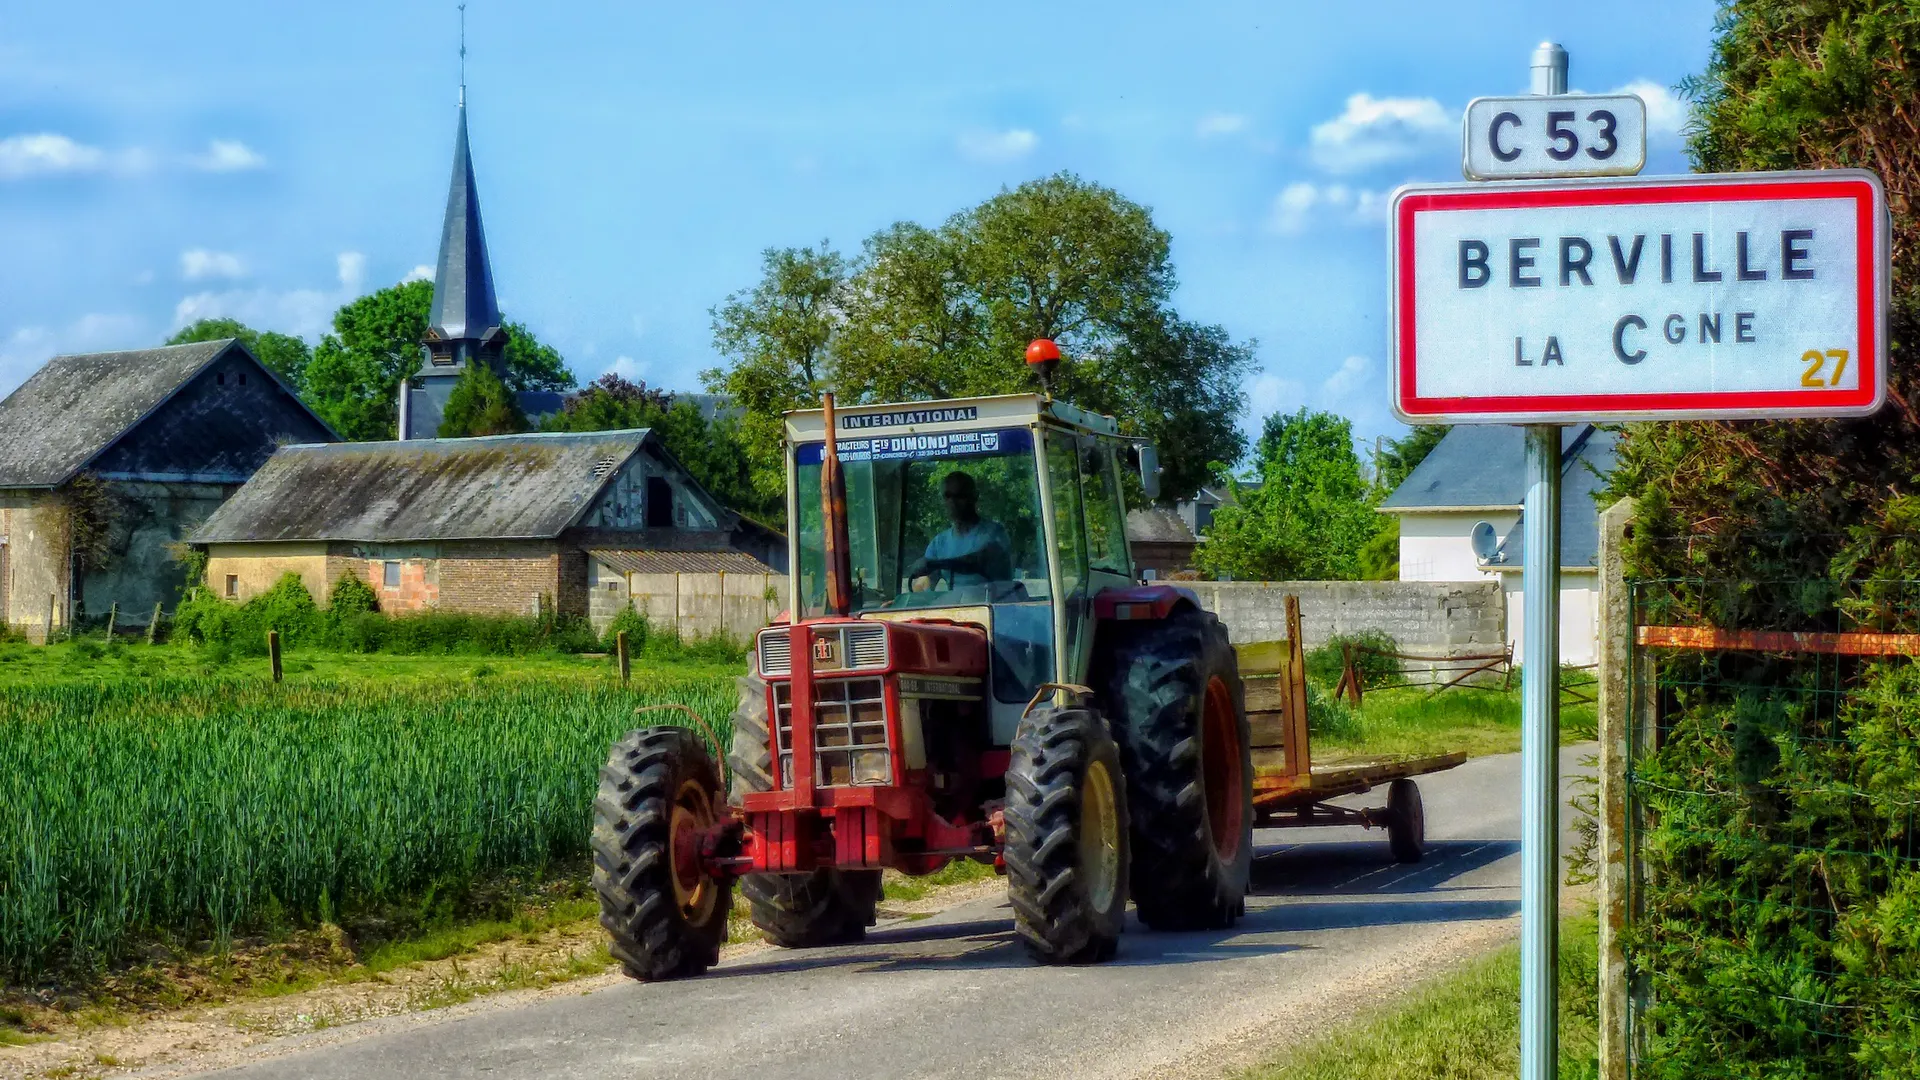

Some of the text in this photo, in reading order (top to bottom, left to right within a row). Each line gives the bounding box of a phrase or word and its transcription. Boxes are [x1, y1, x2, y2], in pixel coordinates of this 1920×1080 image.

[1489, 110, 1617, 162] C 53
[1458, 230, 1814, 289] BERVILLE
[1515, 336, 1563, 366] LA
[1801, 349, 1849, 387] 27
[844, 408, 976, 428] INTERNATIONAL
[891, 435, 948, 451] DIMOND
[950, 443, 981, 454] AGRICOLE
[984, 437, 996, 446] BP
